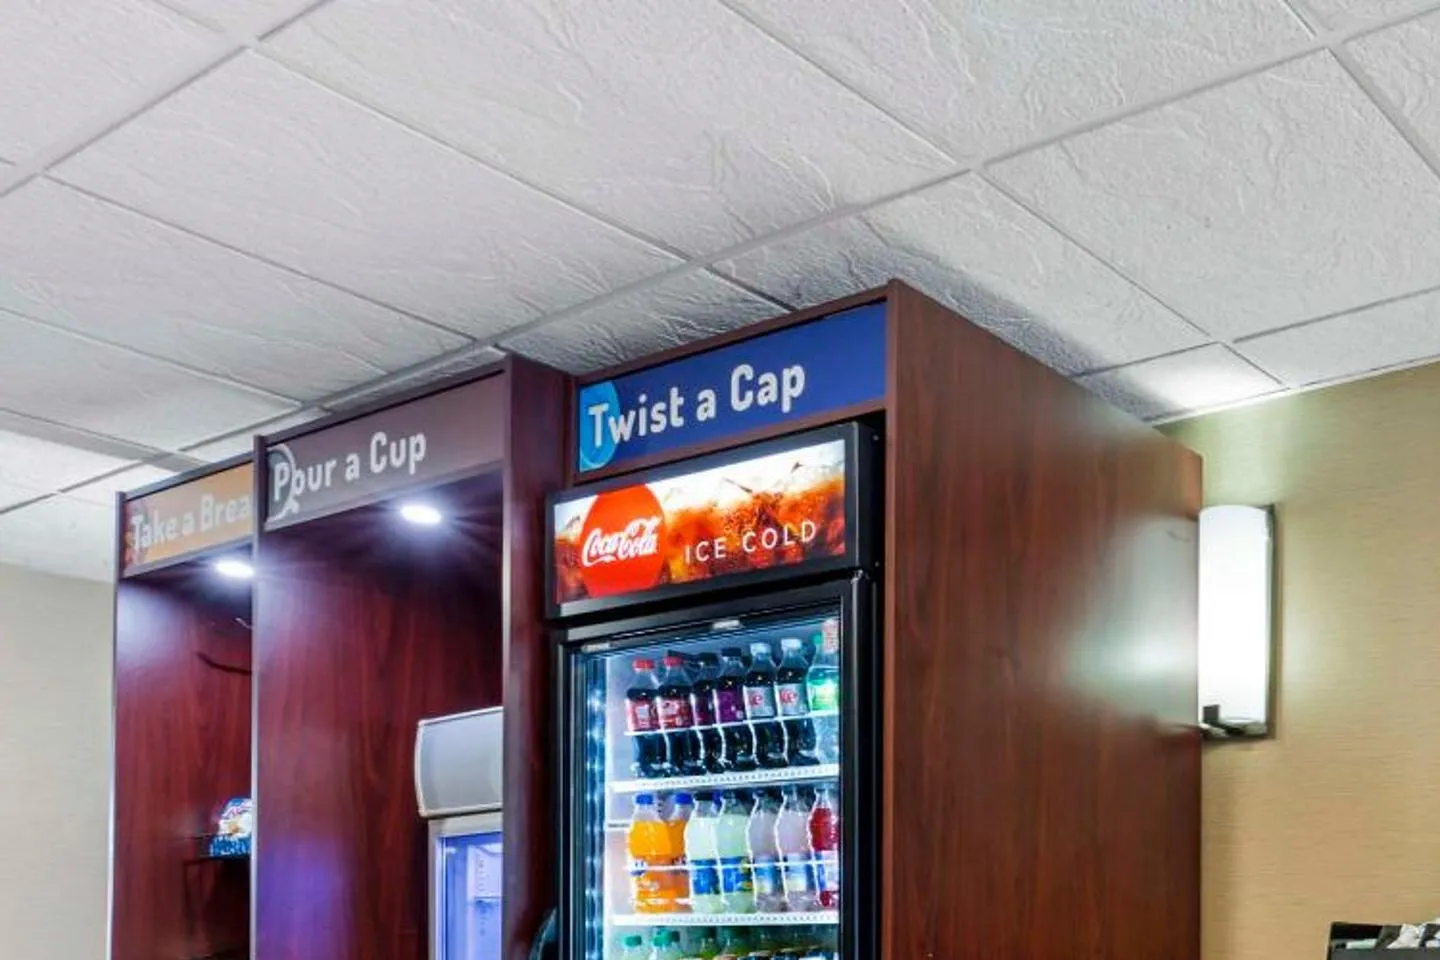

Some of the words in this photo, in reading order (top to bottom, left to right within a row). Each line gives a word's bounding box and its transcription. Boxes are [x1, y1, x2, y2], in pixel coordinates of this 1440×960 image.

[588, 386, 685, 448] Twist
[696, 387, 717, 421] a
[730, 363, 807, 413] Cap
[273, 457, 337, 501] Pour
[345, 452, 360, 481] a
[370, 431, 426, 475] Cup
[131, 508, 178, 550] Take
[182, 511, 196, 537] a
[200, 493, 251, 533] Brea
[685, 537, 728, 564] ICE
[742, 520, 817, 553] COLD
